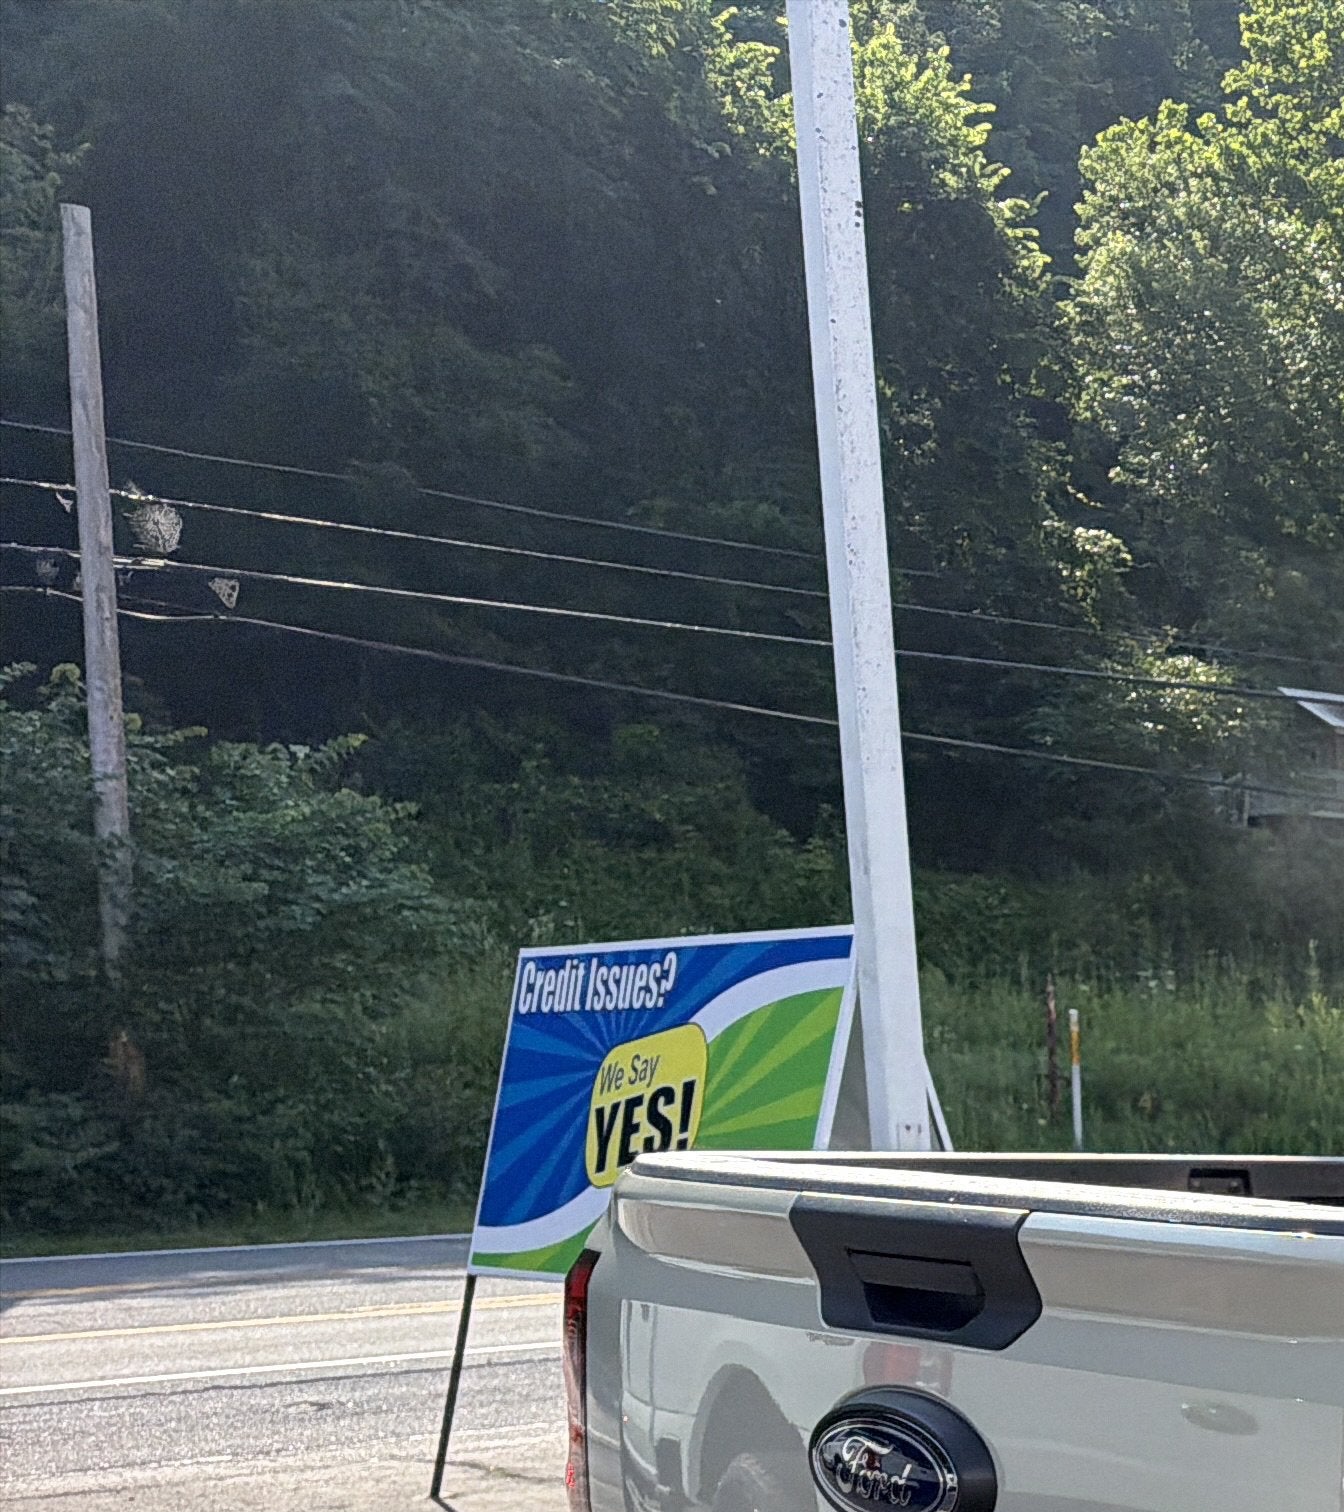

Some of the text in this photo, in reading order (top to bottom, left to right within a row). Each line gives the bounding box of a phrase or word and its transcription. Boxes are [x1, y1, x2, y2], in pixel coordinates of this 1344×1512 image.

[518, 951, 677, 1014] Credit Issues?
[600, 1053, 661, 1095] We Say
[594, 1079, 697, 1174] YES!
[836, 1435, 920, 1507] Ford
